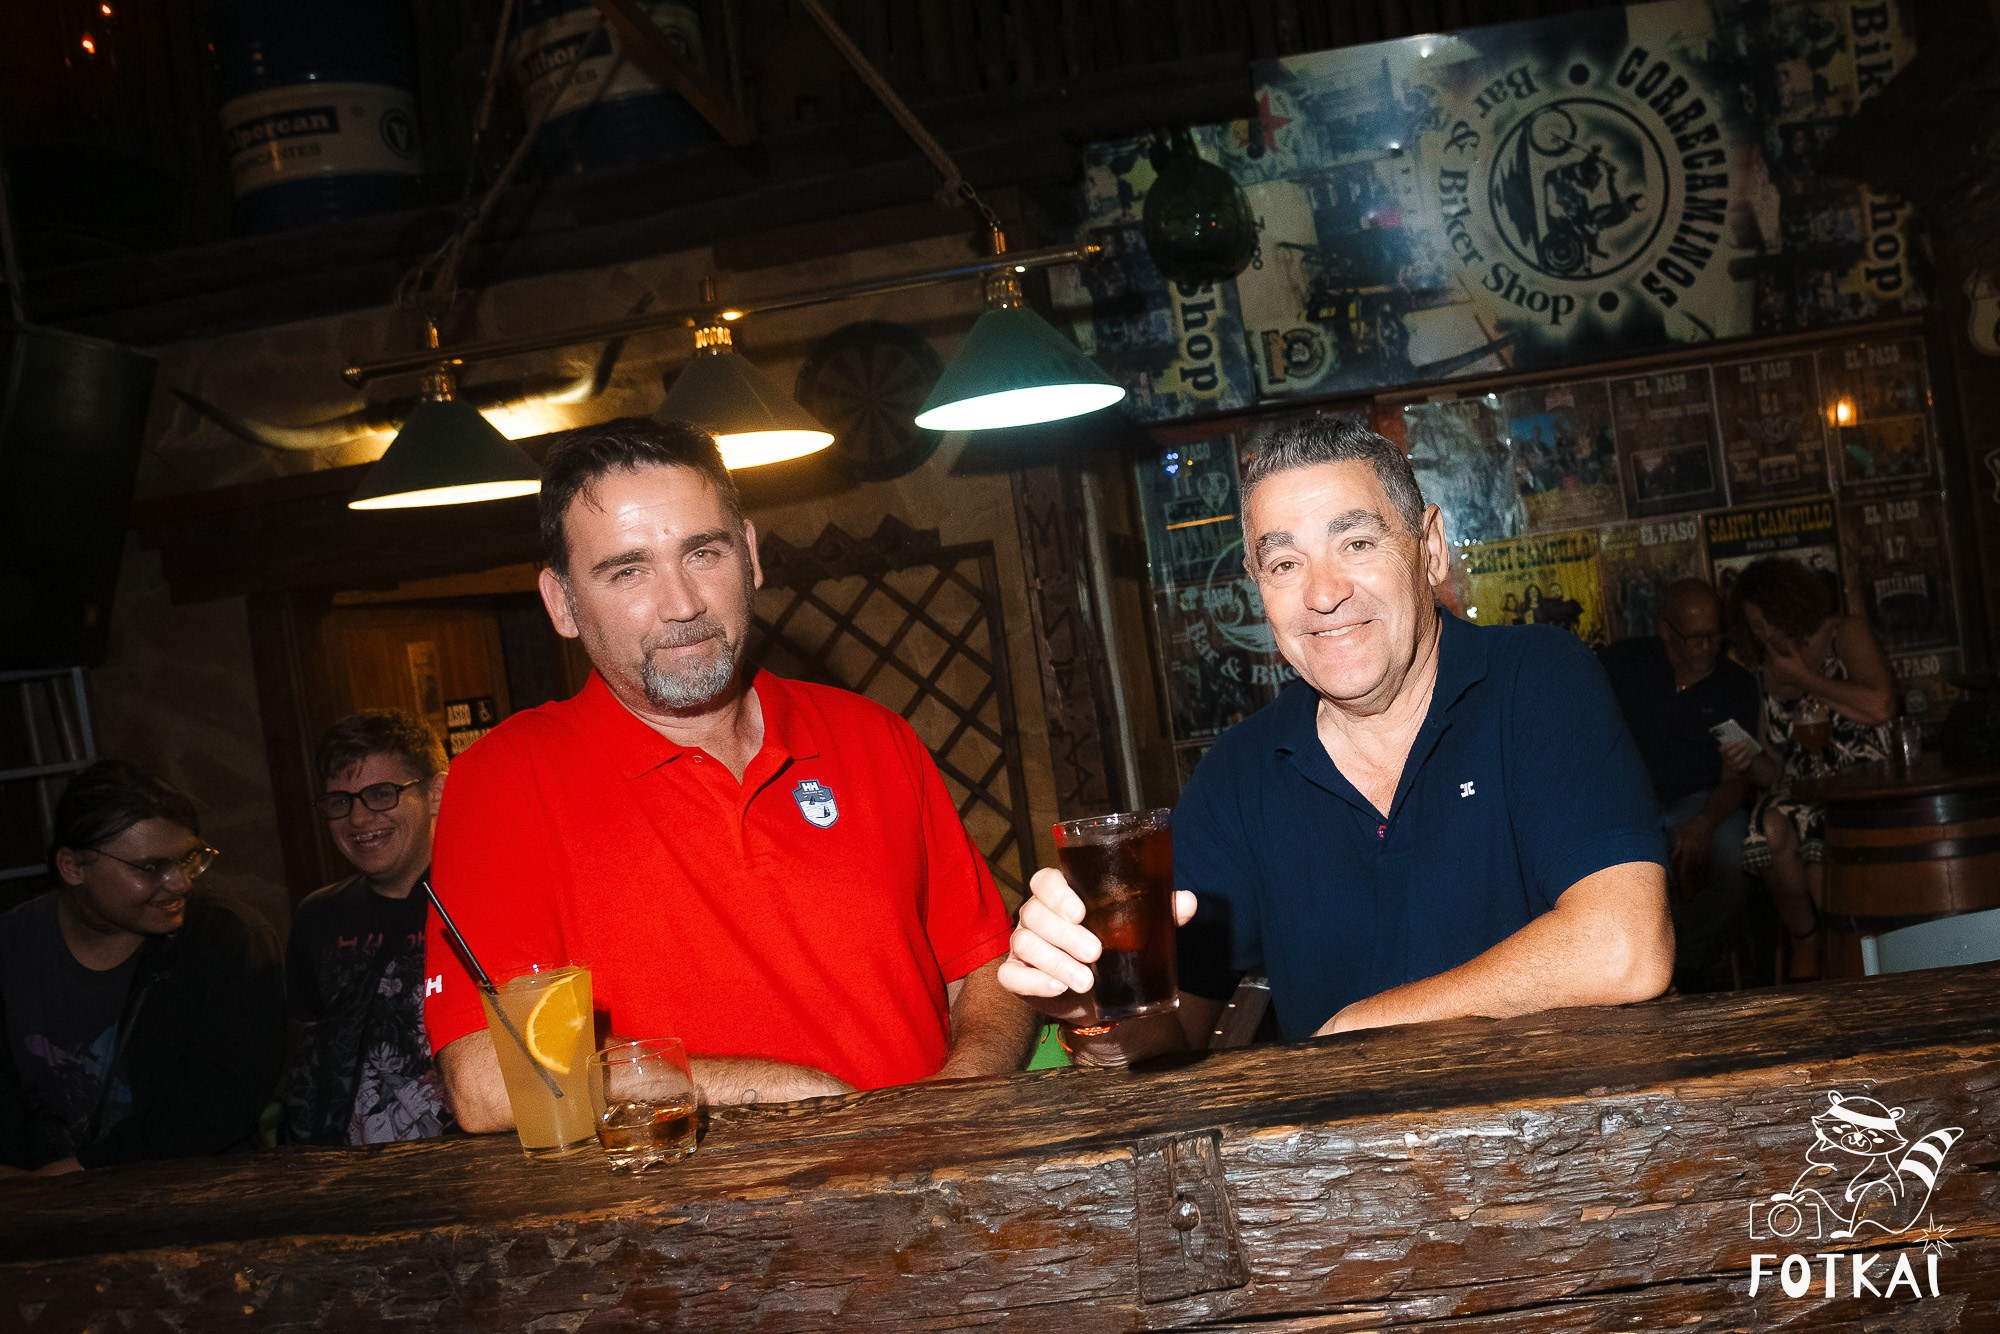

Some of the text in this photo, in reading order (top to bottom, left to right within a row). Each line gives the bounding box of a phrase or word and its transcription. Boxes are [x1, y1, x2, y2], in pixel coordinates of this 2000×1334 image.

[1439, 65, 1576, 326] Bar & Biker Shop
[1616, 47, 1729, 308] CORRECAMINOS
[1864, 200, 1904, 292] hop
[1659, 520, 1698, 544] PASO
[1707, 502, 1833, 544] SANTI CAMPILLO
[1186, 620, 1221, 665] Bar
[801, 781, 820, 792] HH
[424, 973, 443, 998] H
